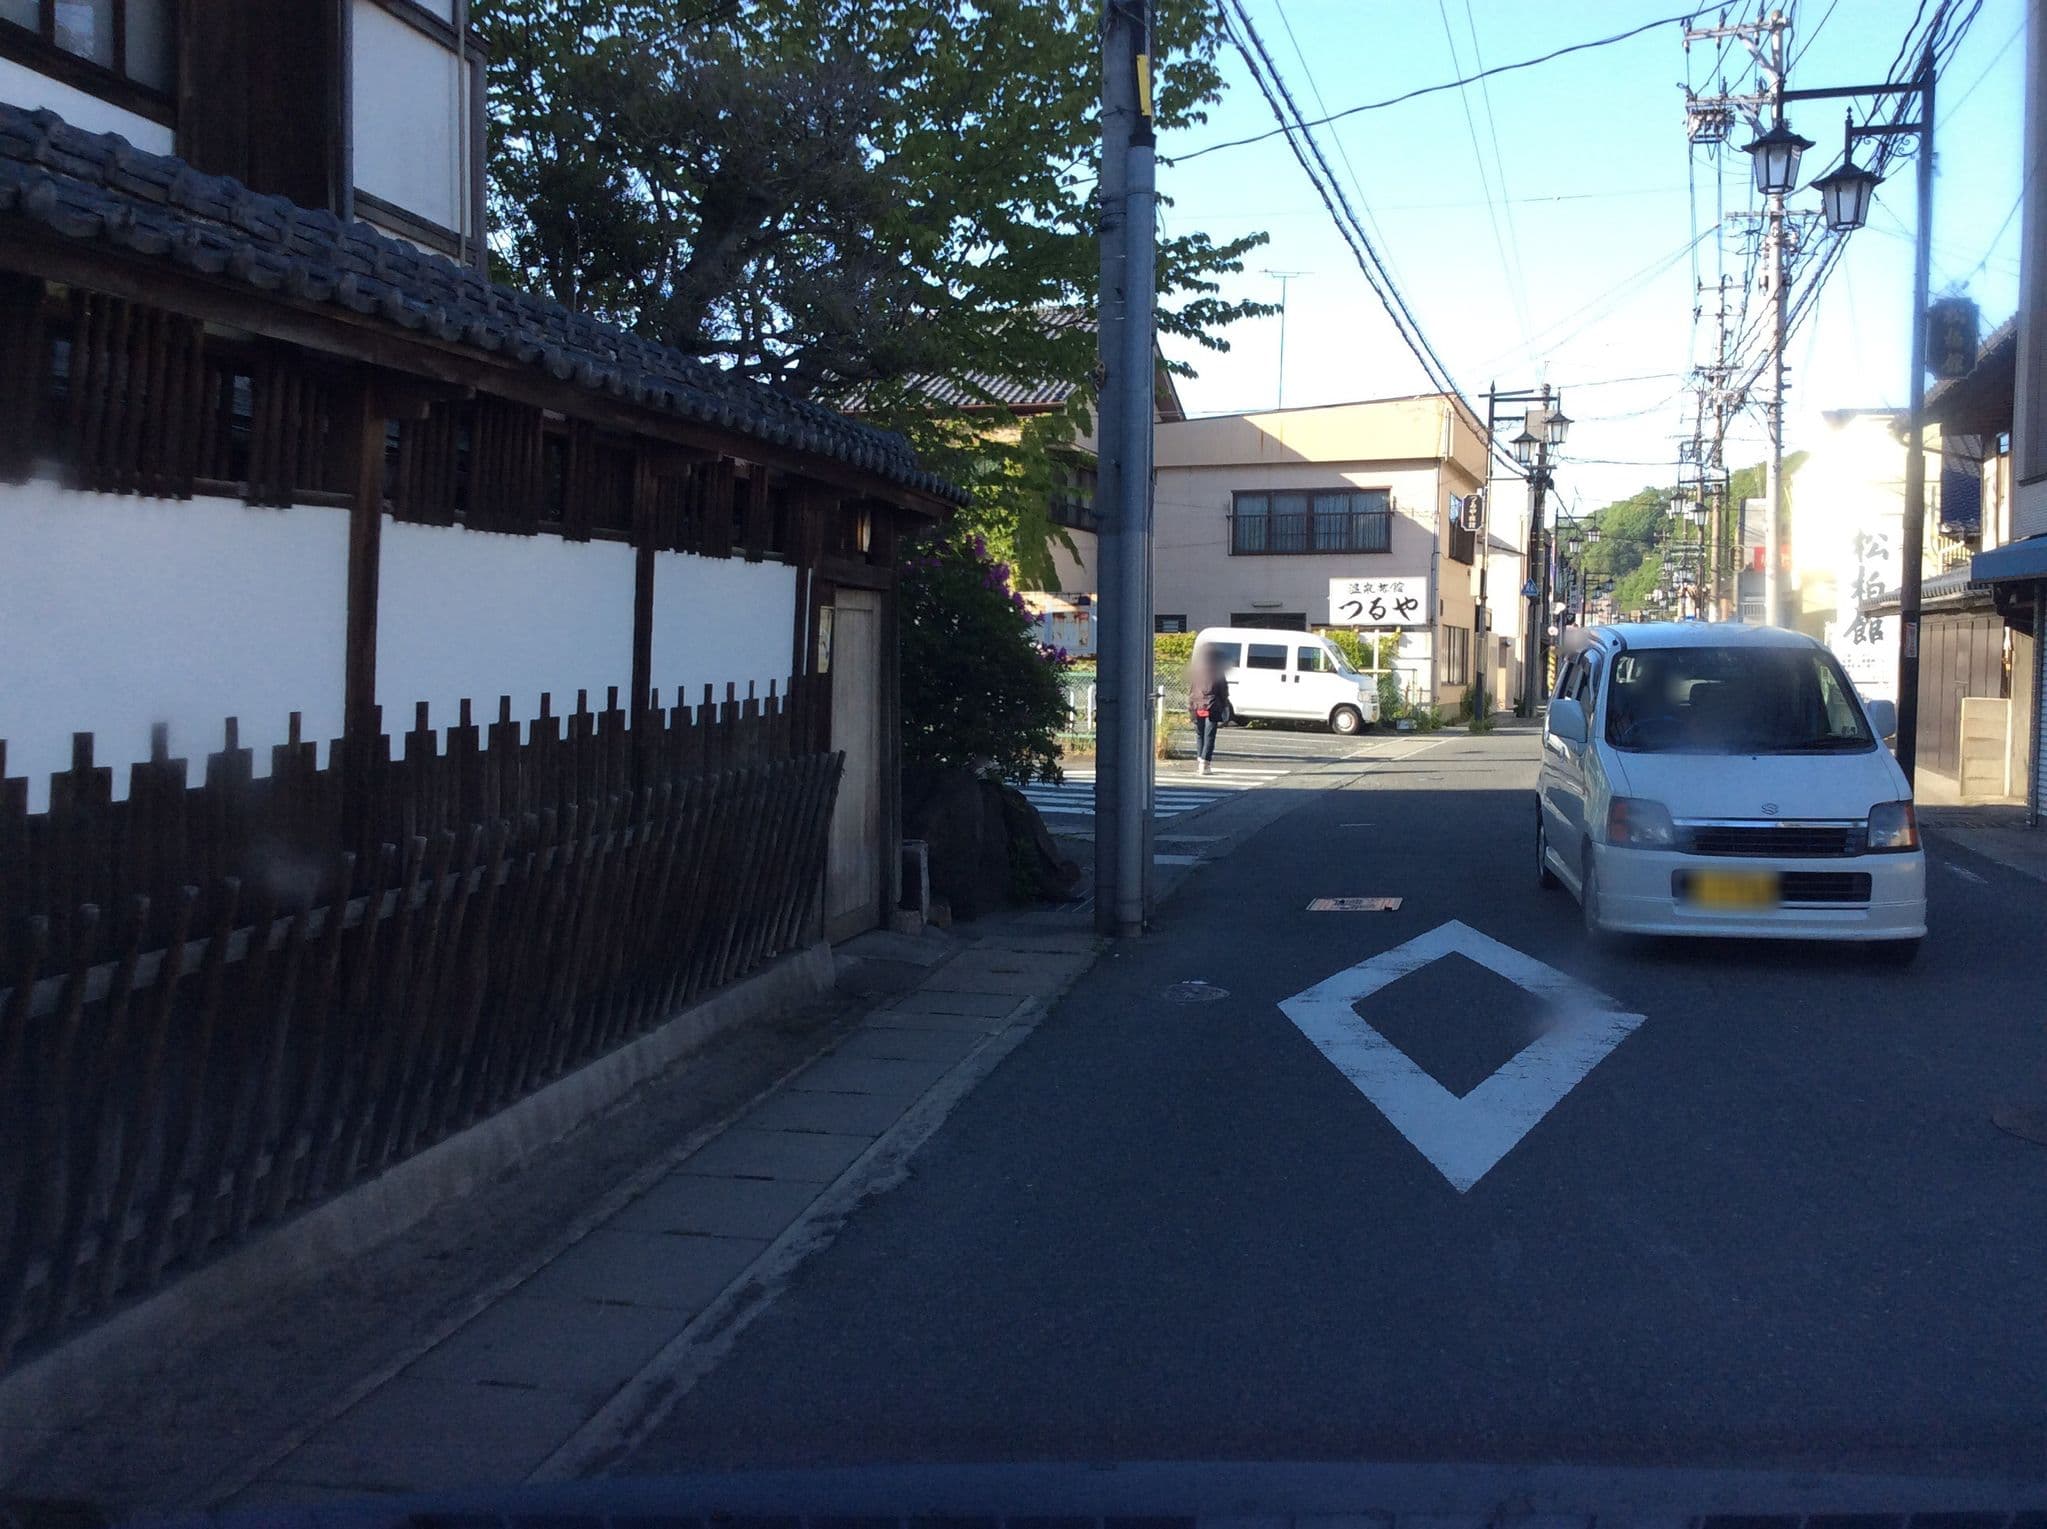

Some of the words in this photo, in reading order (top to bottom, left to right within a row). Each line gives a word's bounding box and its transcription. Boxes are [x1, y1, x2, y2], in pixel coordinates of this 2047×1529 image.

[1338, 596, 1418, 621] つるや
[1843, 530, 1889, 645] 松柏館
